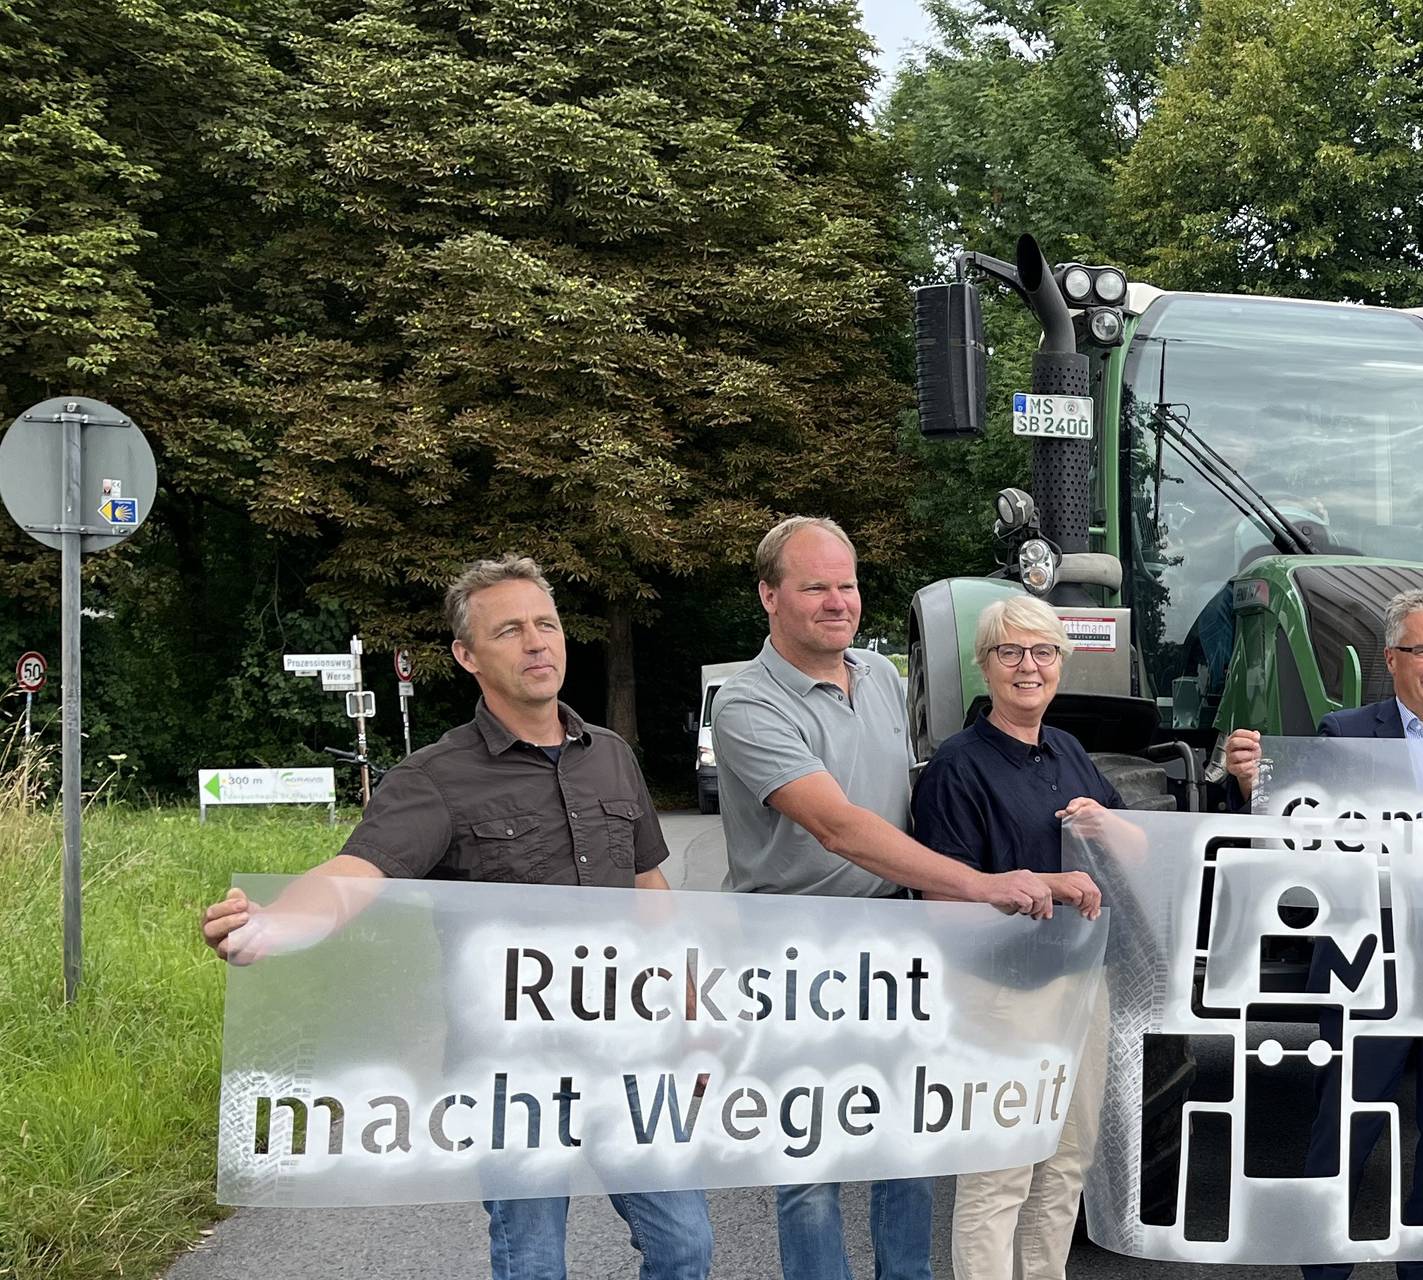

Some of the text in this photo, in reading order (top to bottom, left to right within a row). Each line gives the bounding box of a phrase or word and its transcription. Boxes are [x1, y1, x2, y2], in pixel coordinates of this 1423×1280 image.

[1030, 398, 1054, 415] MS
[1016, 415, 1089, 436] SB 2400
[1063, 622, 1112, 634] ottmann
[24, 663, 41, 680] 50
[286, 658, 352, 669] Prozessionsweg
[326, 672, 352, 681] Werse
[228, 776, 250, 785] 300
[504, 945, 932, 1022] Rücksicht
[253, 1057, 1069, 1159] macht Wege breit
